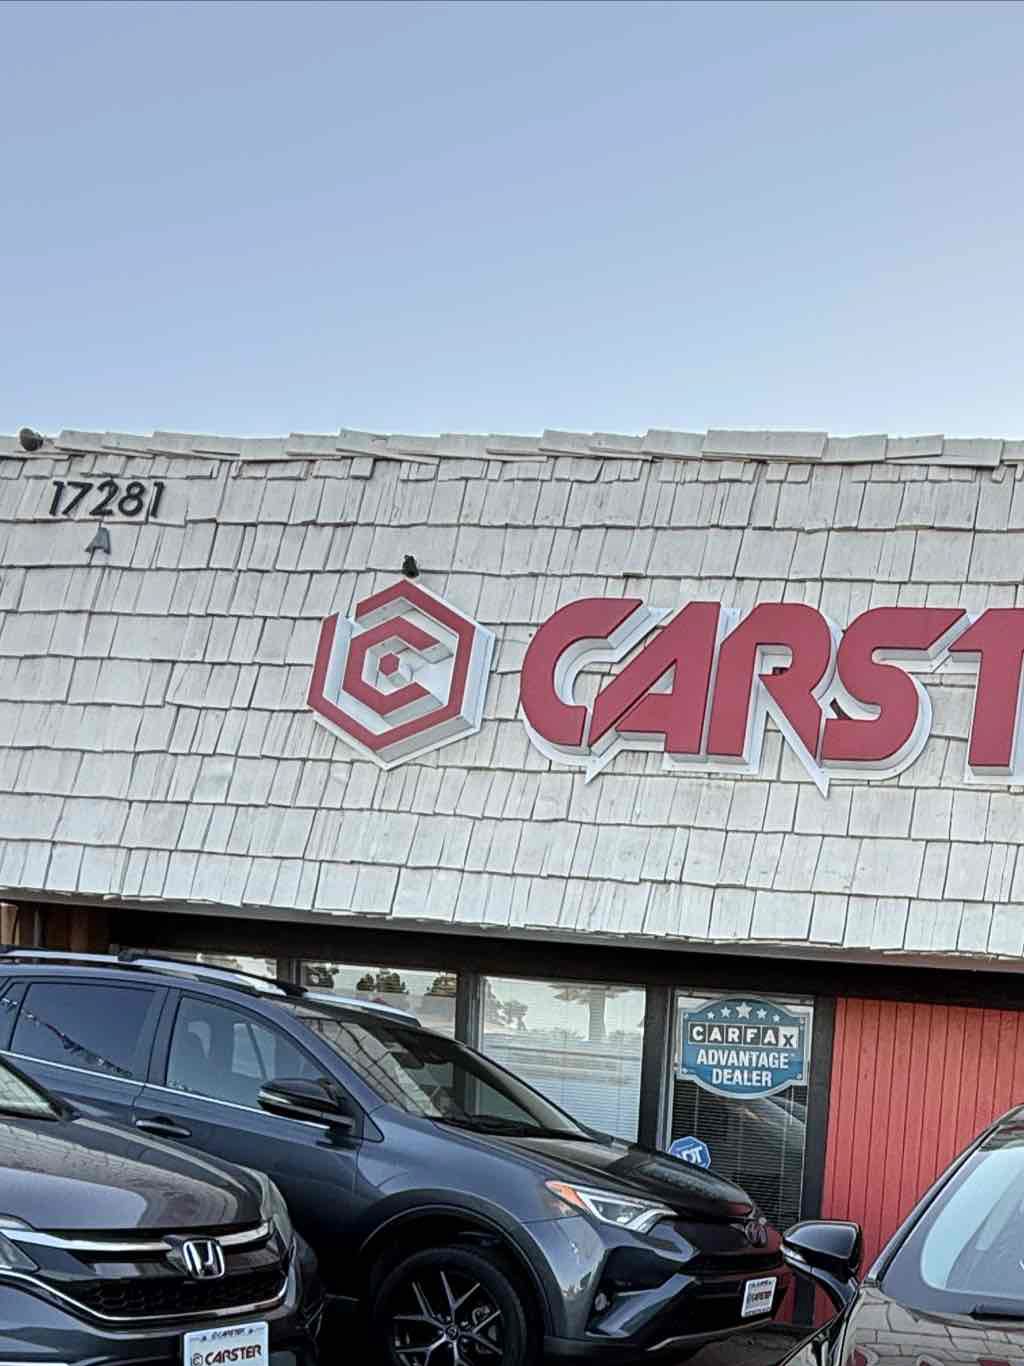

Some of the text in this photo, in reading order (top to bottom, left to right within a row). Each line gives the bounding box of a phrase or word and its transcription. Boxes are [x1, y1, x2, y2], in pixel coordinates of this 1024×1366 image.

[49, 480, 165, 518] 17281
[84, 527, 111, 554] A
[691, 1025, 798, 1048] CARFAX
[696, 1049, 790, 1069] ADVANTAGE
[711, 1068, 773, 1087] DEALER
[205, 1344, 262, 1366] CARSTER
